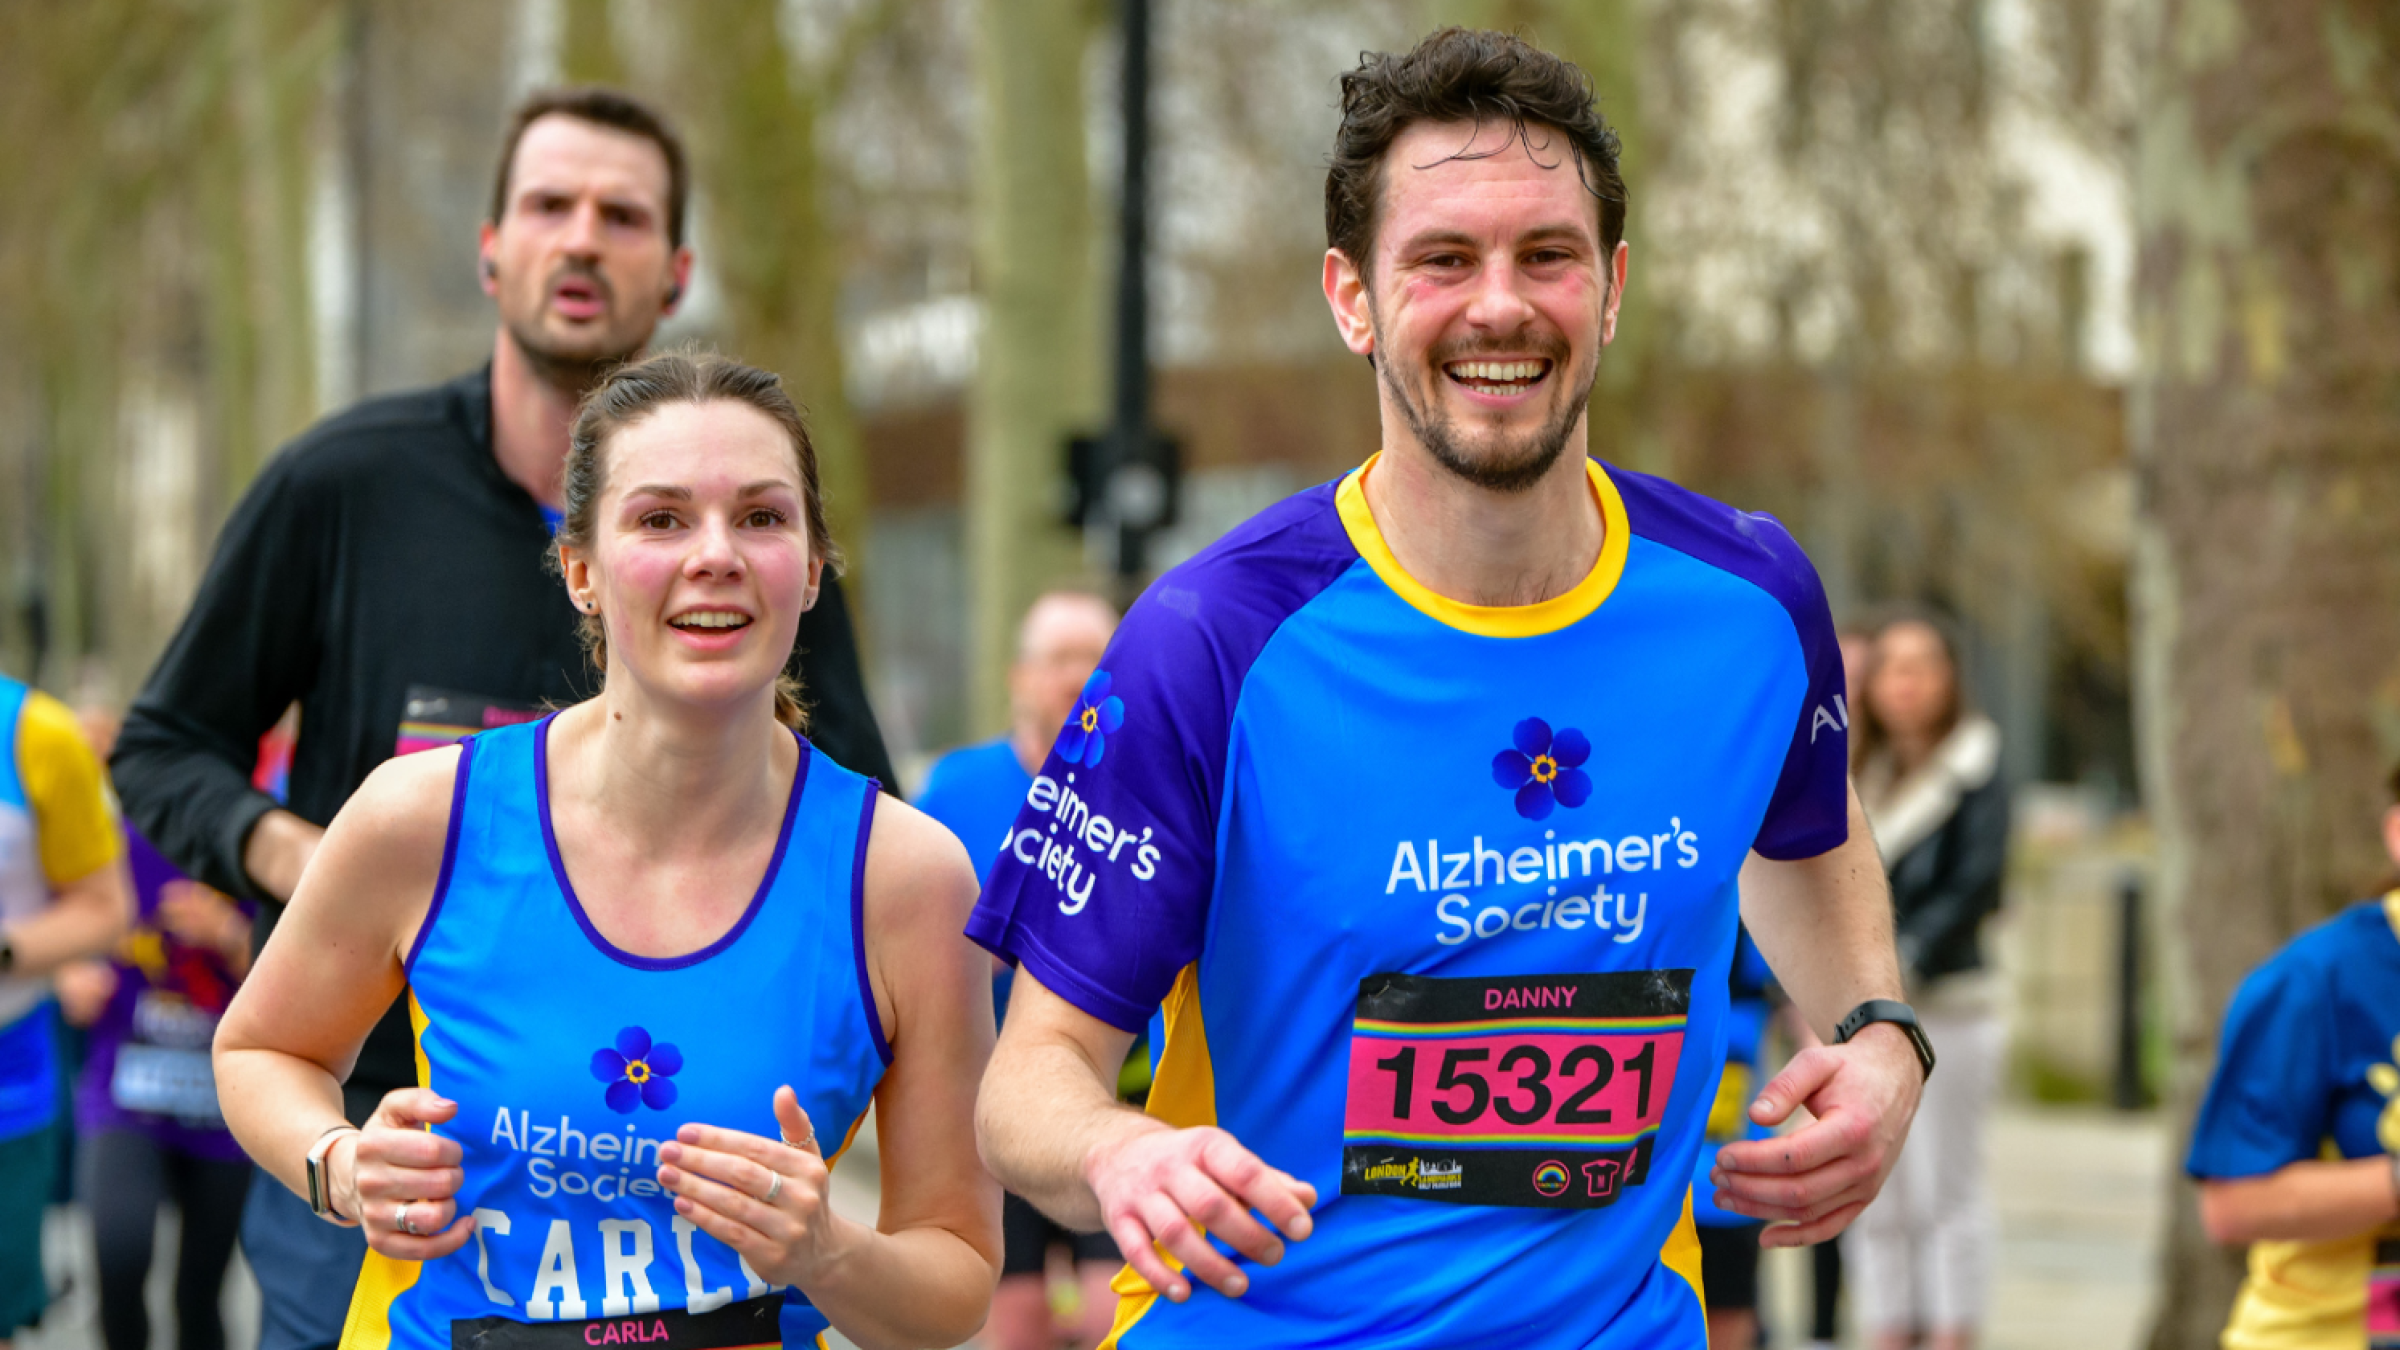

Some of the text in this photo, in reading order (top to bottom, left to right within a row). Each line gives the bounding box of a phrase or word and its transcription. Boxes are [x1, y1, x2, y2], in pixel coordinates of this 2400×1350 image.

[1000, 822, 1096, 916] ciety
[1385, 816, 1699, 894] Alzheimer's
[1435, 884, 1648, 945] Society
[1484, 986, 1577, 1010] DANNY
[1376, 1041, 1656, 1126] 15321
[1364, 1163, 1408, 1182] LONDON
[584, 1319, 669, 1345] CARLA
